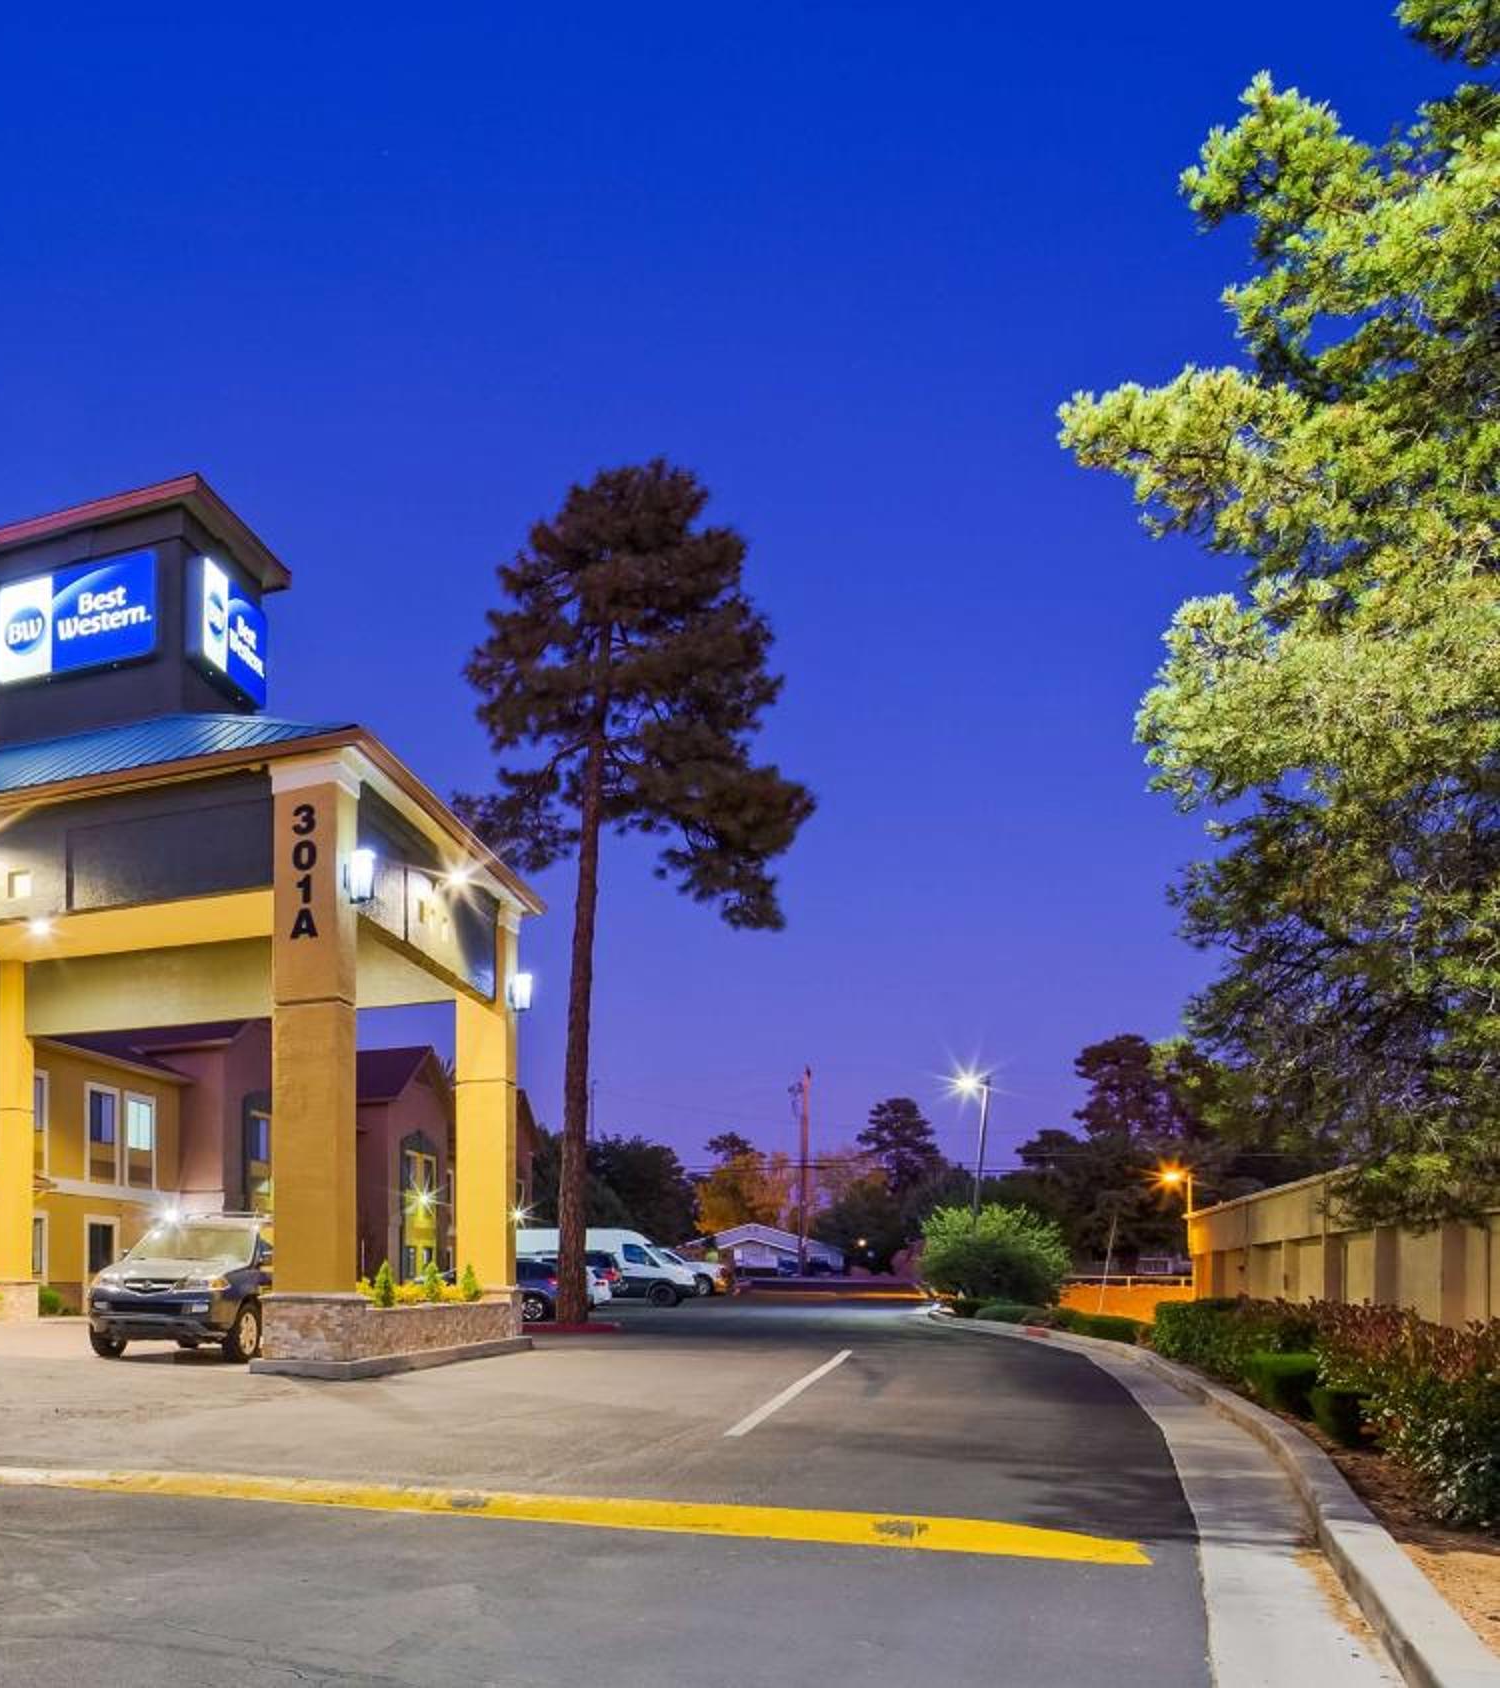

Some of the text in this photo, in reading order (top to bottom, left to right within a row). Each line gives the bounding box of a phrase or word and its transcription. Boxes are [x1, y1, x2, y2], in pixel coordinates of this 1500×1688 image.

[79, 586, 127, 614] Best
[8, 617, 43, 645] BW
[291, 804, 318, 939] 301A
